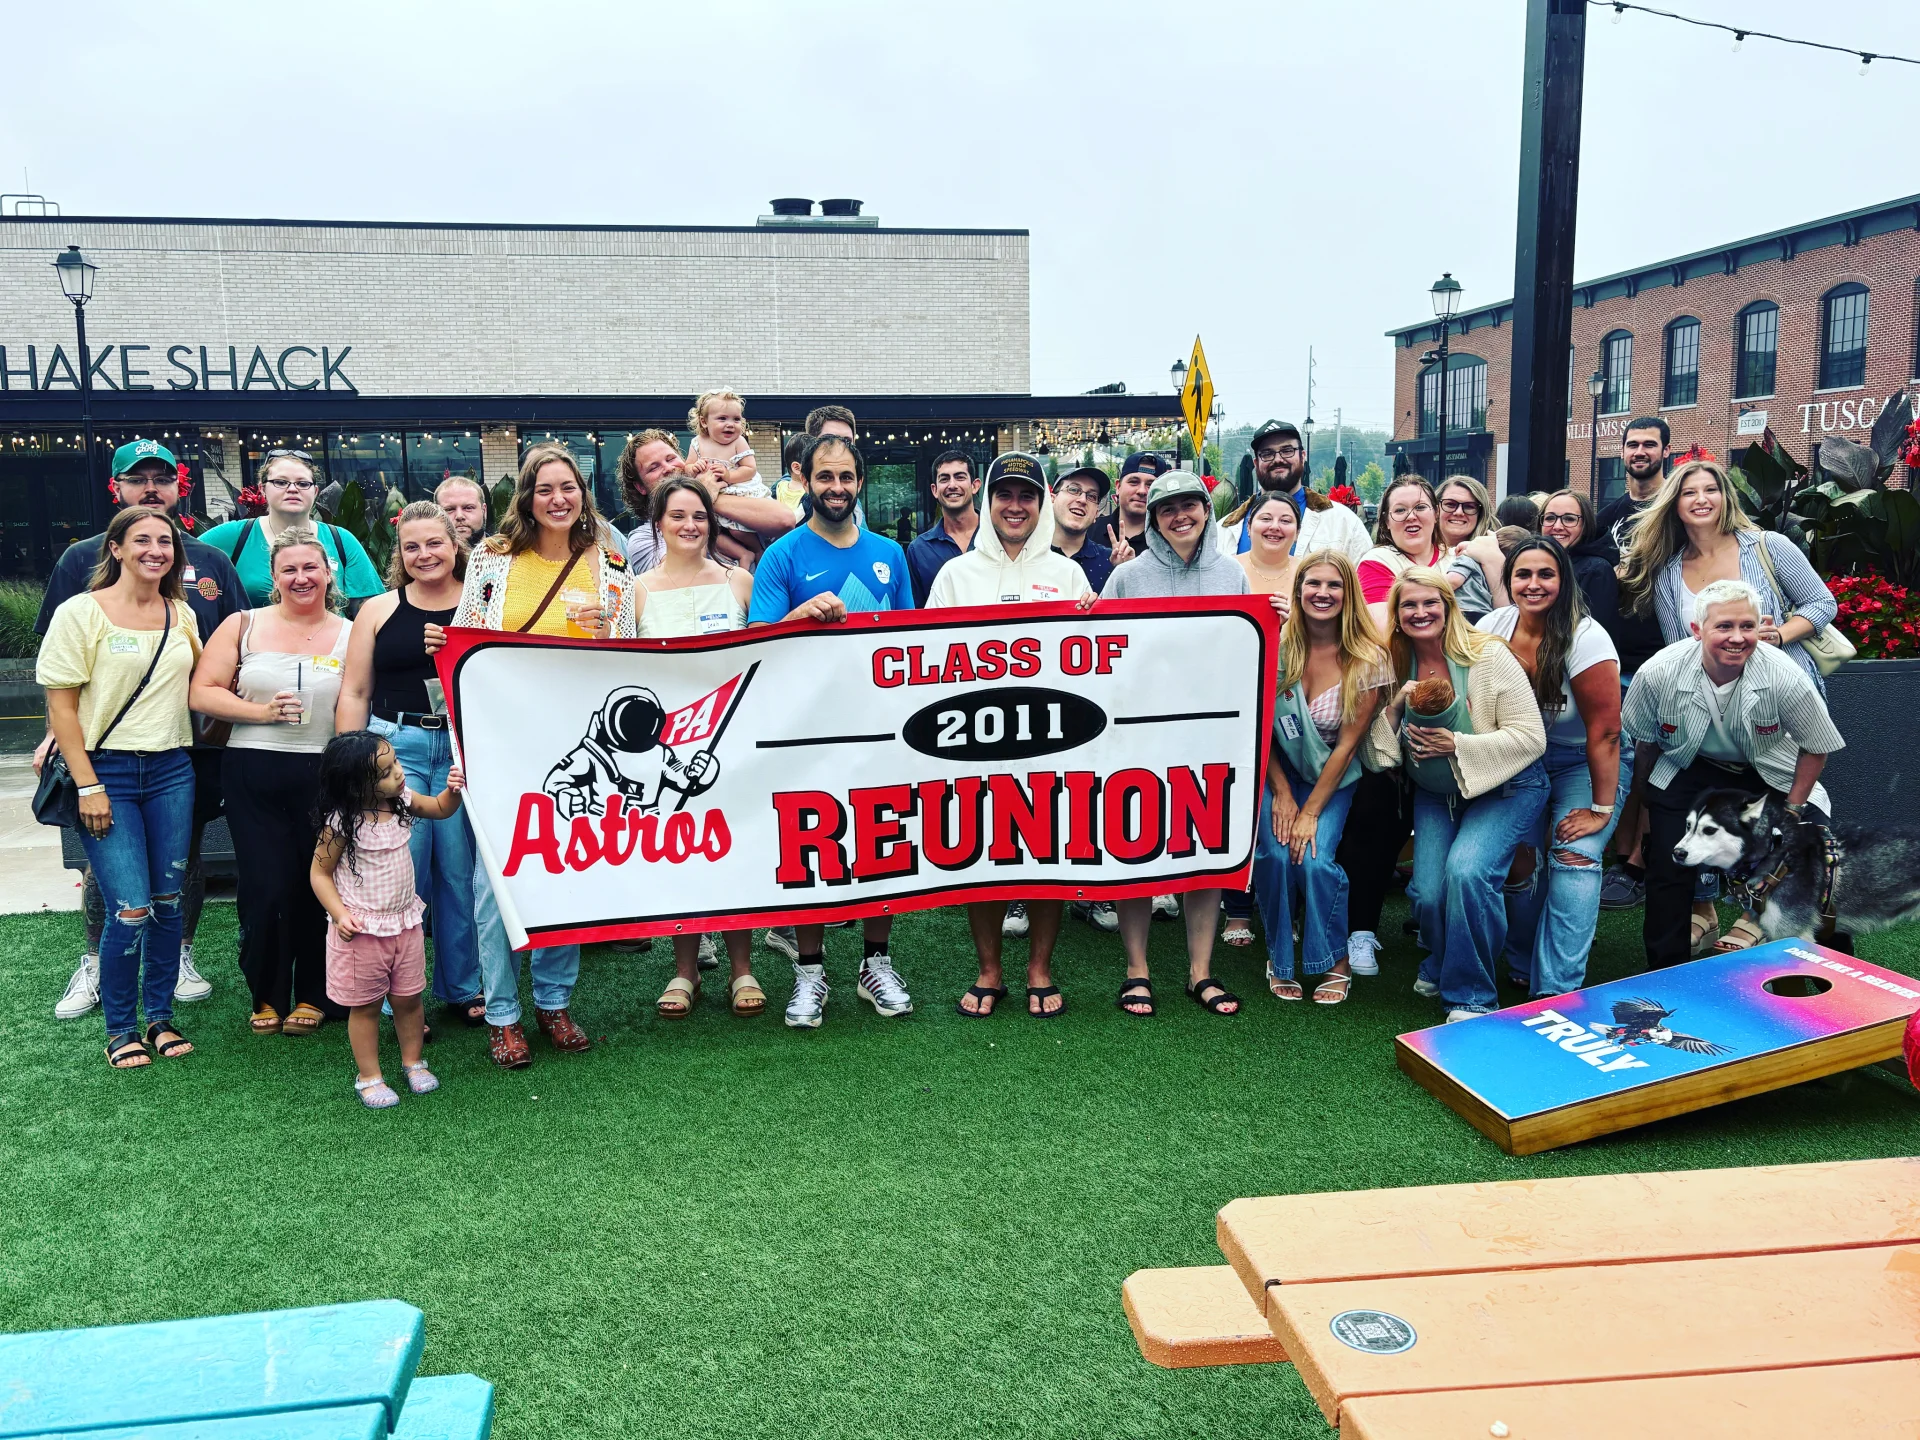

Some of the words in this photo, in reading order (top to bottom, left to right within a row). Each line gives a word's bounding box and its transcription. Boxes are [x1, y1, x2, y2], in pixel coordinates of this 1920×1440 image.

[167, 345, 358, 391] SHACK
[1740, 420, 1750, 428] EST
[1751, 418, 1765, 427] 2010
[1001, 457, 1034, 468] INDIANAPOLIS
[1003, 467, 1030, 475] SPEEDWAY
[872, 637, 1042, 688] CLASS
[1060, 634, 1128, 676] OF
[667, 691, 719, 746] PA
[936, 702, 1064, 748] 2011
[502, 791, 732, 877] Astros
[772, 763, 1235, 889] REUNION
[1783, 947, 1829, 964] DRINK
[1821, 961, 1855, 974] LIKE
[1521, 1009, 1651, 1073] TRULY
